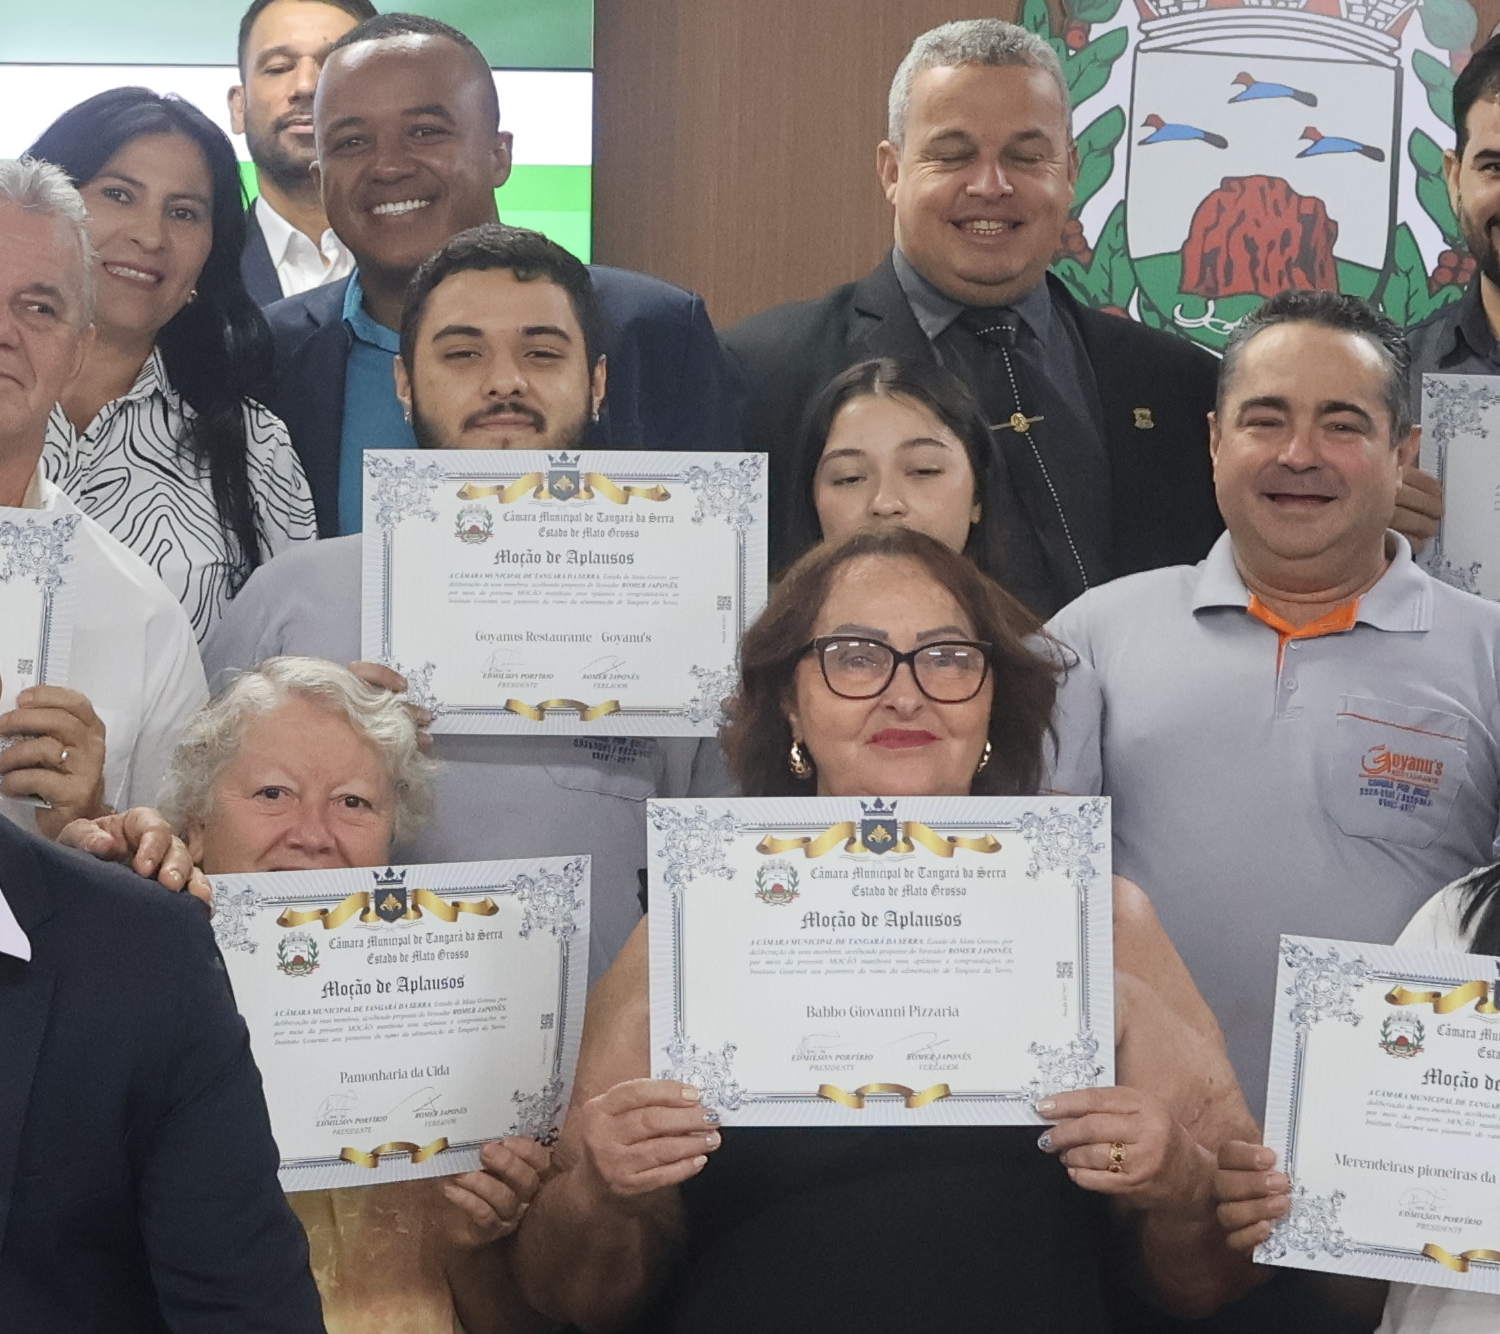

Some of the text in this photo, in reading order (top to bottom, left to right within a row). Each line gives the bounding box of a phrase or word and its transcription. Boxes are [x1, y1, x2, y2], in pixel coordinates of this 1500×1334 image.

[493, 548, 635, 568] Moção de Aplausos
[526, 630, 593, 643] Restaurante
[800, 910, 962, 932] Moção de Aplausos
[320, 974, 465, 1000] Moção de Aplausos
[806, 1005, 847, 1018] Babbo
[909, 1004, 960, 1017] Pizzaria
[340, 1068, 408, 1084] Pamonharia
[410, 1066, 424, 1079] da
[1421, 1067, 1479, 1092] Moção
[1335, 1153, 1415, 1174] Merendeiras
[1417, 1164, 1478, 1181] pioneiras
[1480, 1170, 1496, 1184] da
